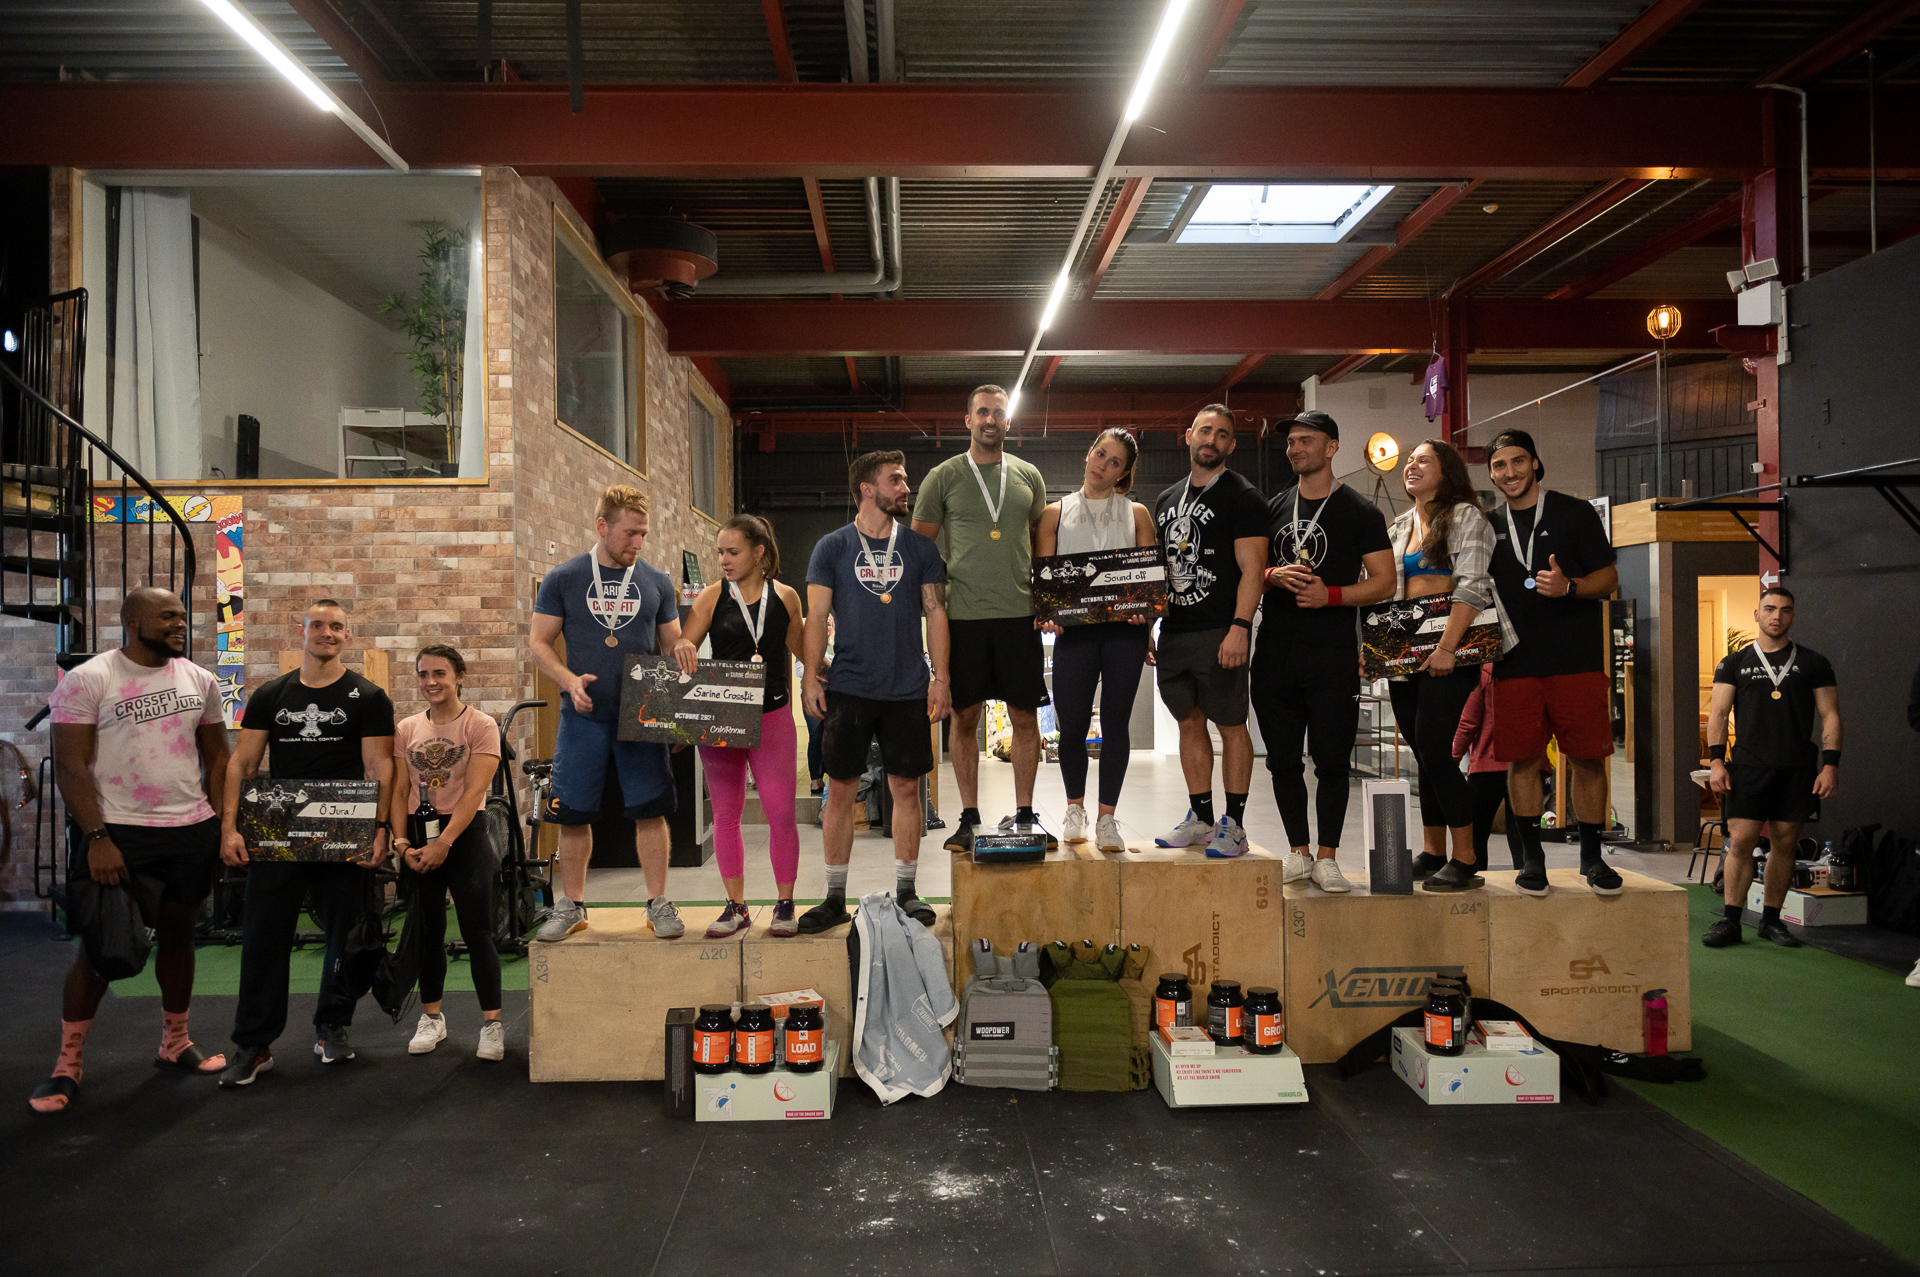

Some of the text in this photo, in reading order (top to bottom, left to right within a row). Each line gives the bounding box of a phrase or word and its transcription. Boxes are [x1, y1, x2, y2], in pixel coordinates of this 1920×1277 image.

[1104, 570, 1147, 583] Sound off
[1419, 596, 1445, 605] WILLIAM
[693, 686, 721, 699] Sarine
[115, 690, 178, 717] CROSSFIT
[134, 697, 202, 721] HAUT JURA
[674, 712, 715, 721] OCTOBRE 2021
[329, 805, 350, 815] Jura
[1540, 985, 1642, 997] SPORTADDICT
[975, 1026, 1010, 1034] WODPOWER
[791, 1042, 817, 1053] LOAD
